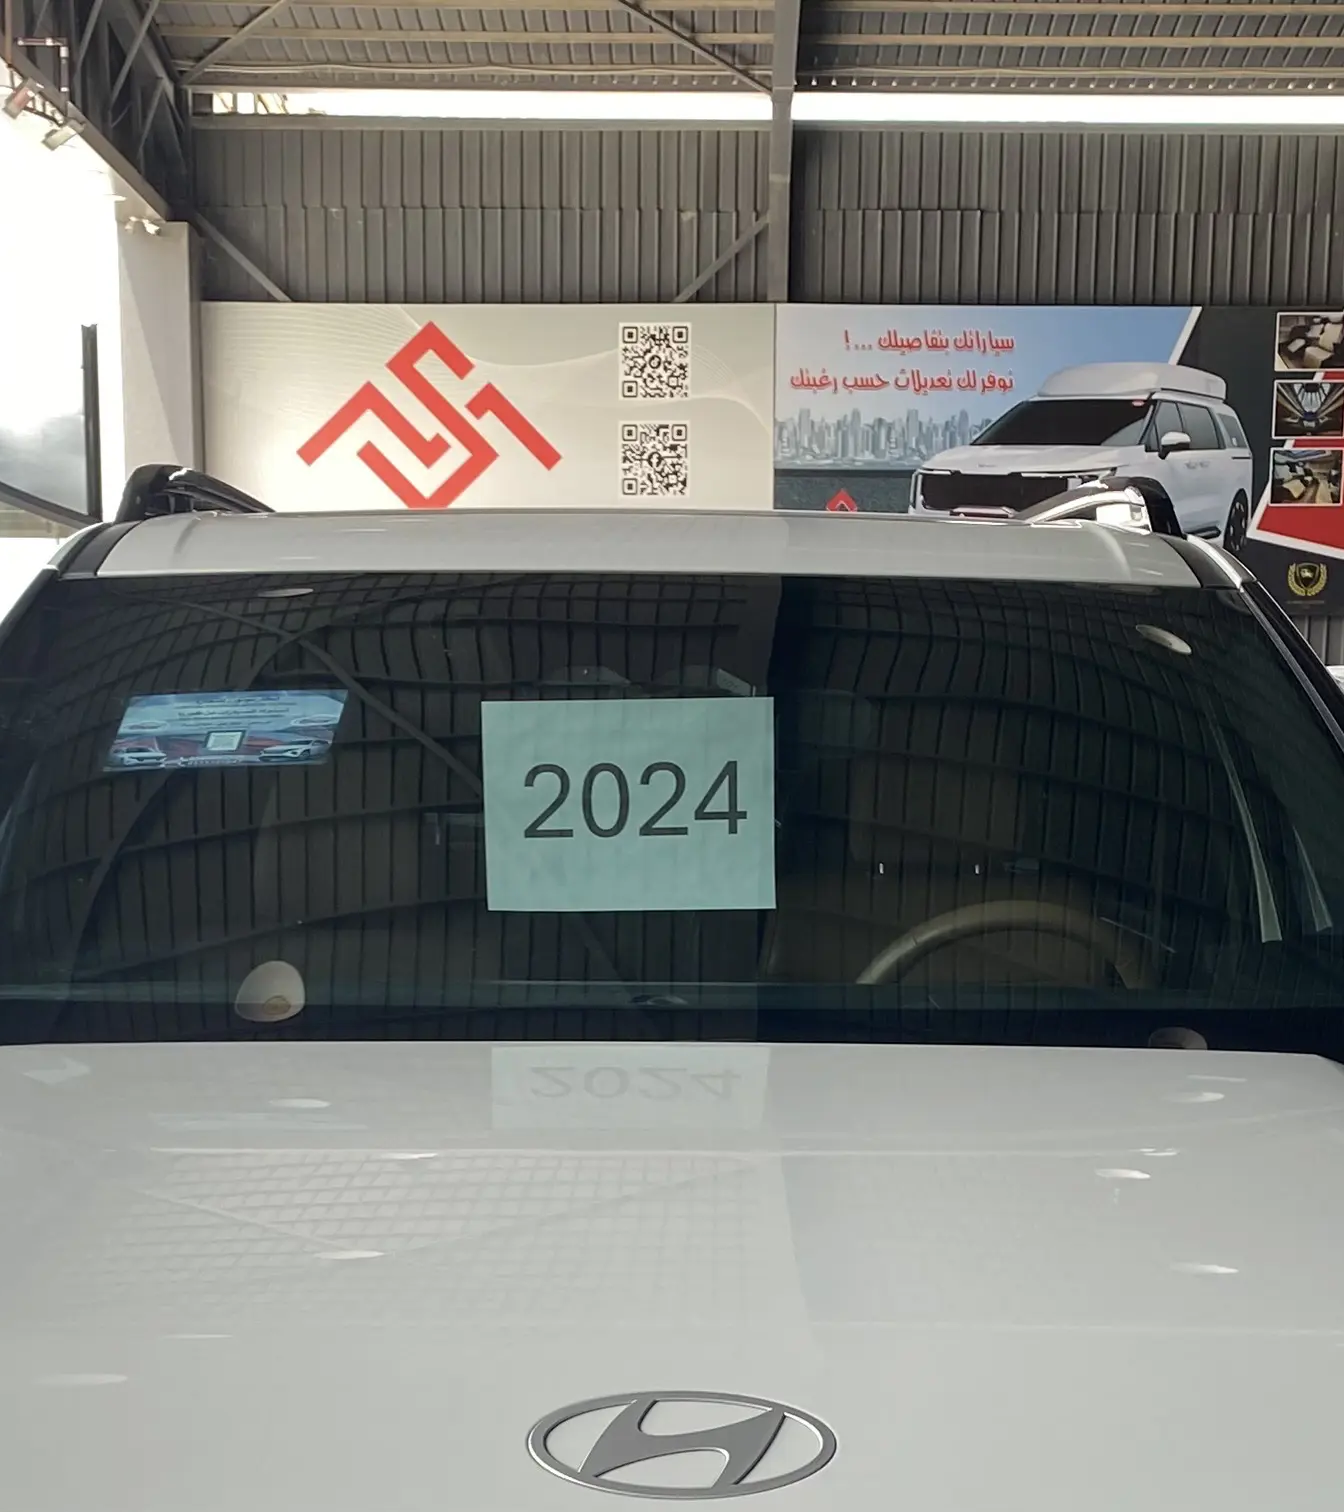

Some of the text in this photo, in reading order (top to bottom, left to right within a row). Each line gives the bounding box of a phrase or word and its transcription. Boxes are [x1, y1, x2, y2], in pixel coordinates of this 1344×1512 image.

[790, 367, 838, 395] رغبتك
[842, 372, 890, 395] حسب
[894, 368, 953, 396] تعديلات
[956, 369, 976, 390] لك
[523, 759, 749, 840] 2024
